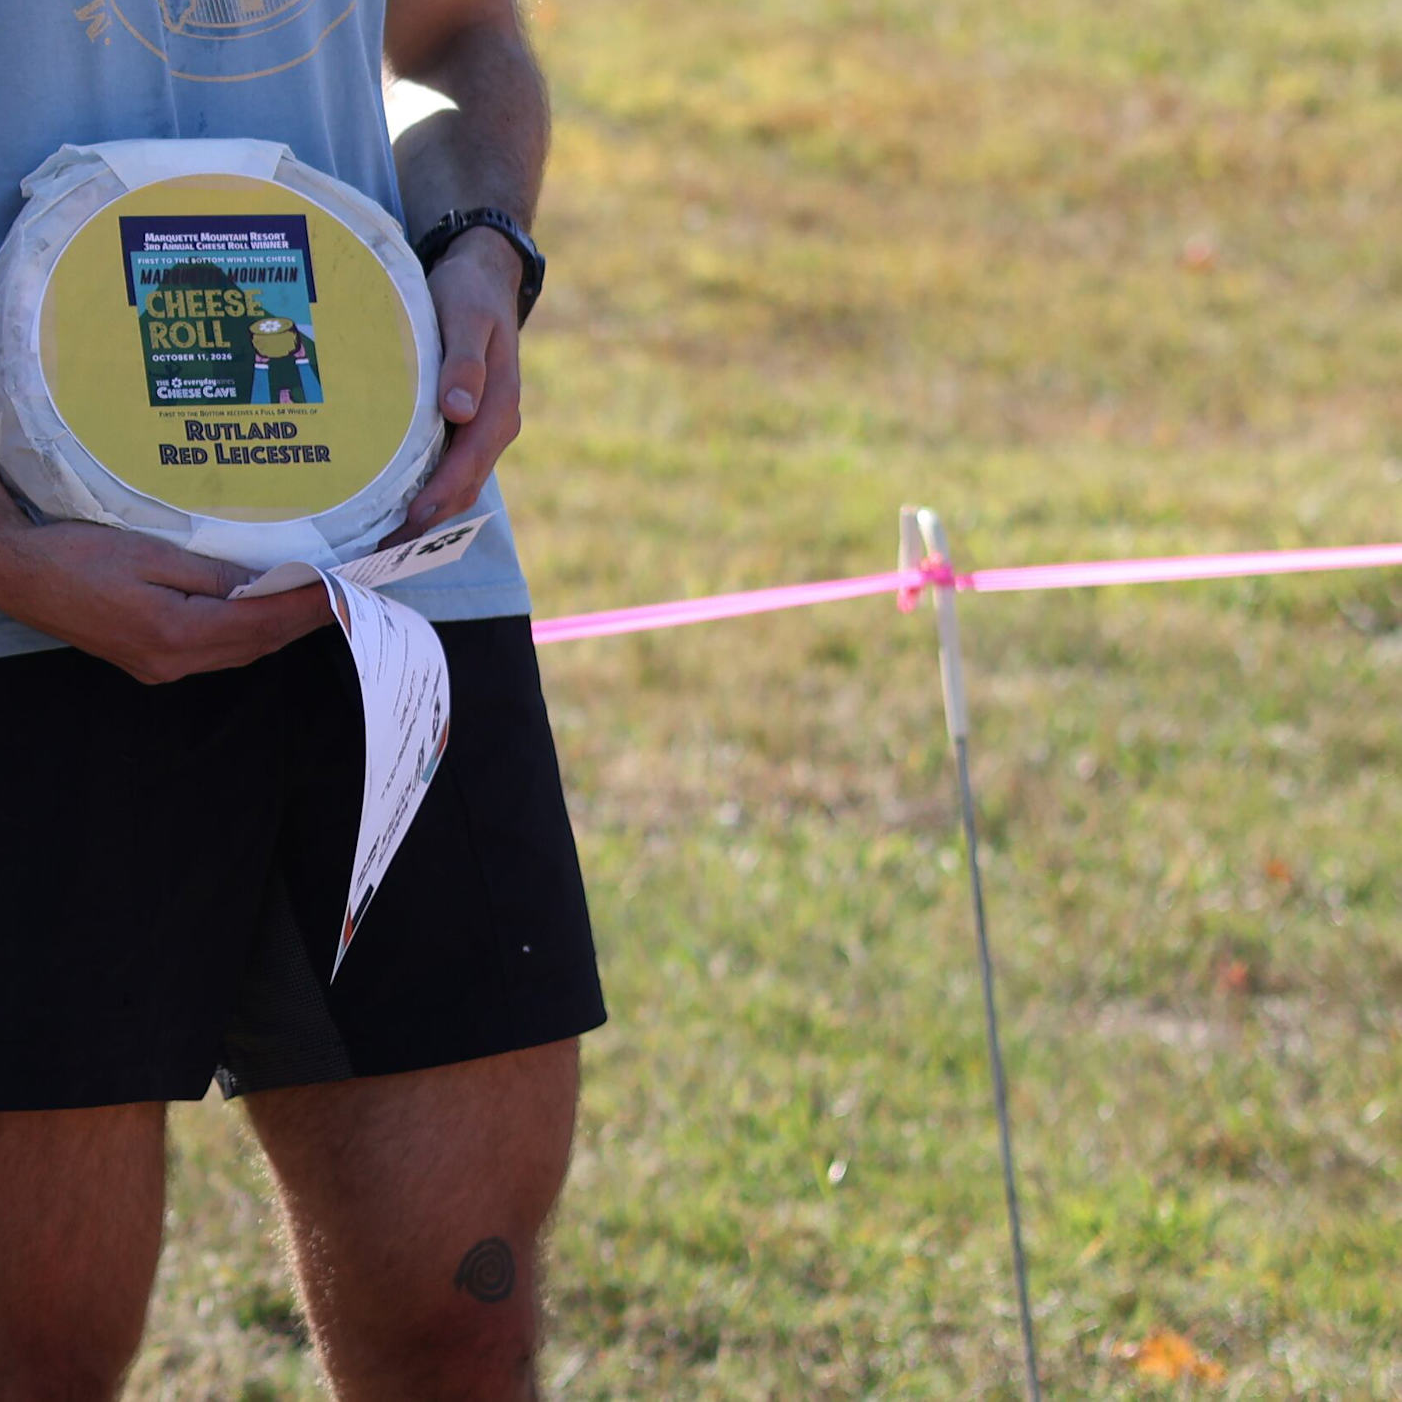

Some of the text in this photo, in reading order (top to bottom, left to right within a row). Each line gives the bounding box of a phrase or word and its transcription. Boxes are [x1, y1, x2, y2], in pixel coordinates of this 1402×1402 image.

[144, 231, 286, 243] MARQUETTE MOUNTAIN RESORT
[162, 242, 195, 251] ANNUAL
[196, 242, 226, 251] CHEESE
[227, 241, 250, 250] ROLL
[250, 240, 289, 249] WINNER
[138, 257, 159, 265] FIRST
[191, 256, 225, 264] BOTTOM
[266, 255, 296, 263] CHEESE
[227, 266, 298, 284] MOUNTAIN
[145, 289, 265, 318] CHEESE
[148, 320, 231, 349] ROLL
[152, 353, 233, 362] OCTOBER 11, 2026
[156, 385, 237, 399] CHEESE CAVE
[184, 419, 297, 441] RUTLAND
[159, 443, 331, 465] RED LEICESTER
